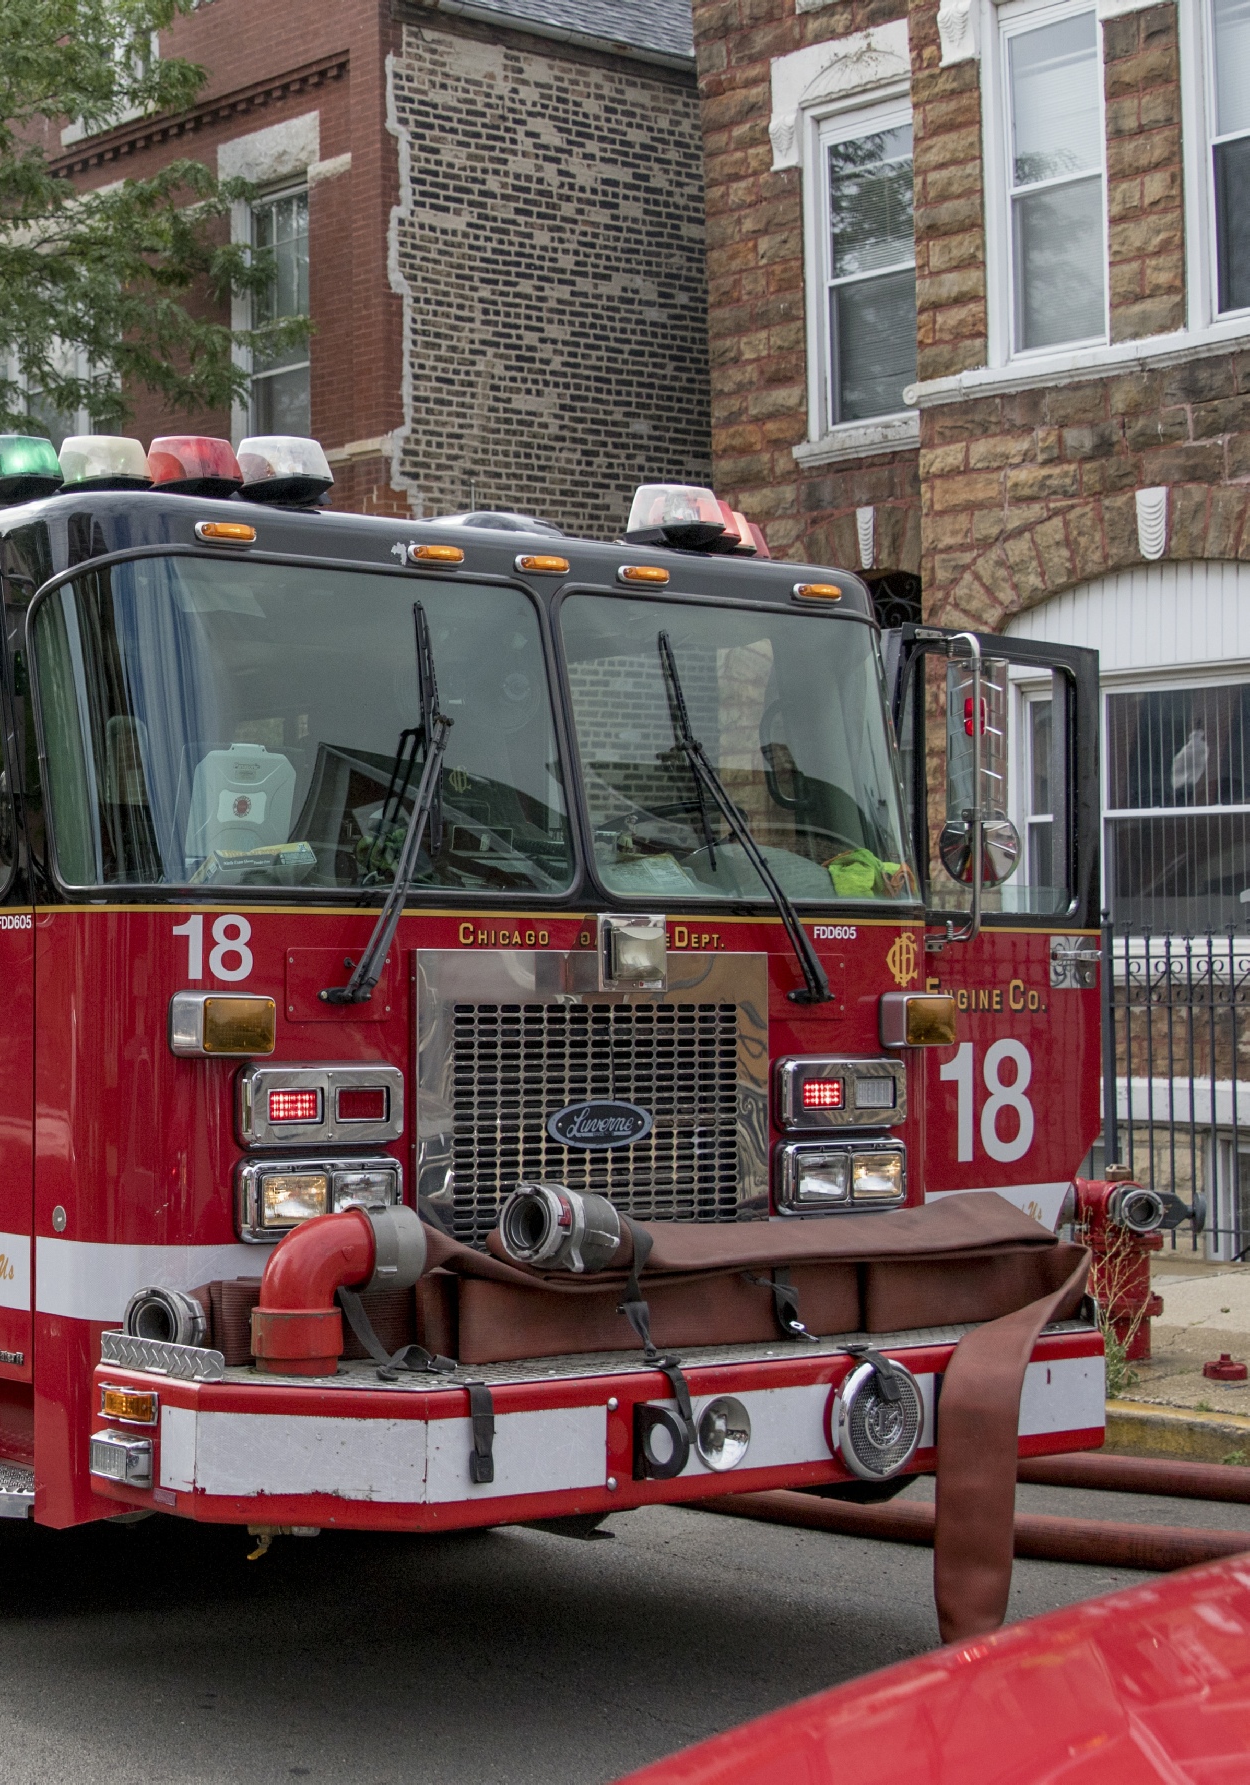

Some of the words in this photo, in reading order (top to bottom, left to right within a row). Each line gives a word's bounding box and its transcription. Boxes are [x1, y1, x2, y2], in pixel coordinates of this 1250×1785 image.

[173, 914, 253, 981] 18
[813, 926, 857, 940] FDD605
[566, 1107, 634, 1137] Luverne
[940, 1038, 1034, 1162] 18
